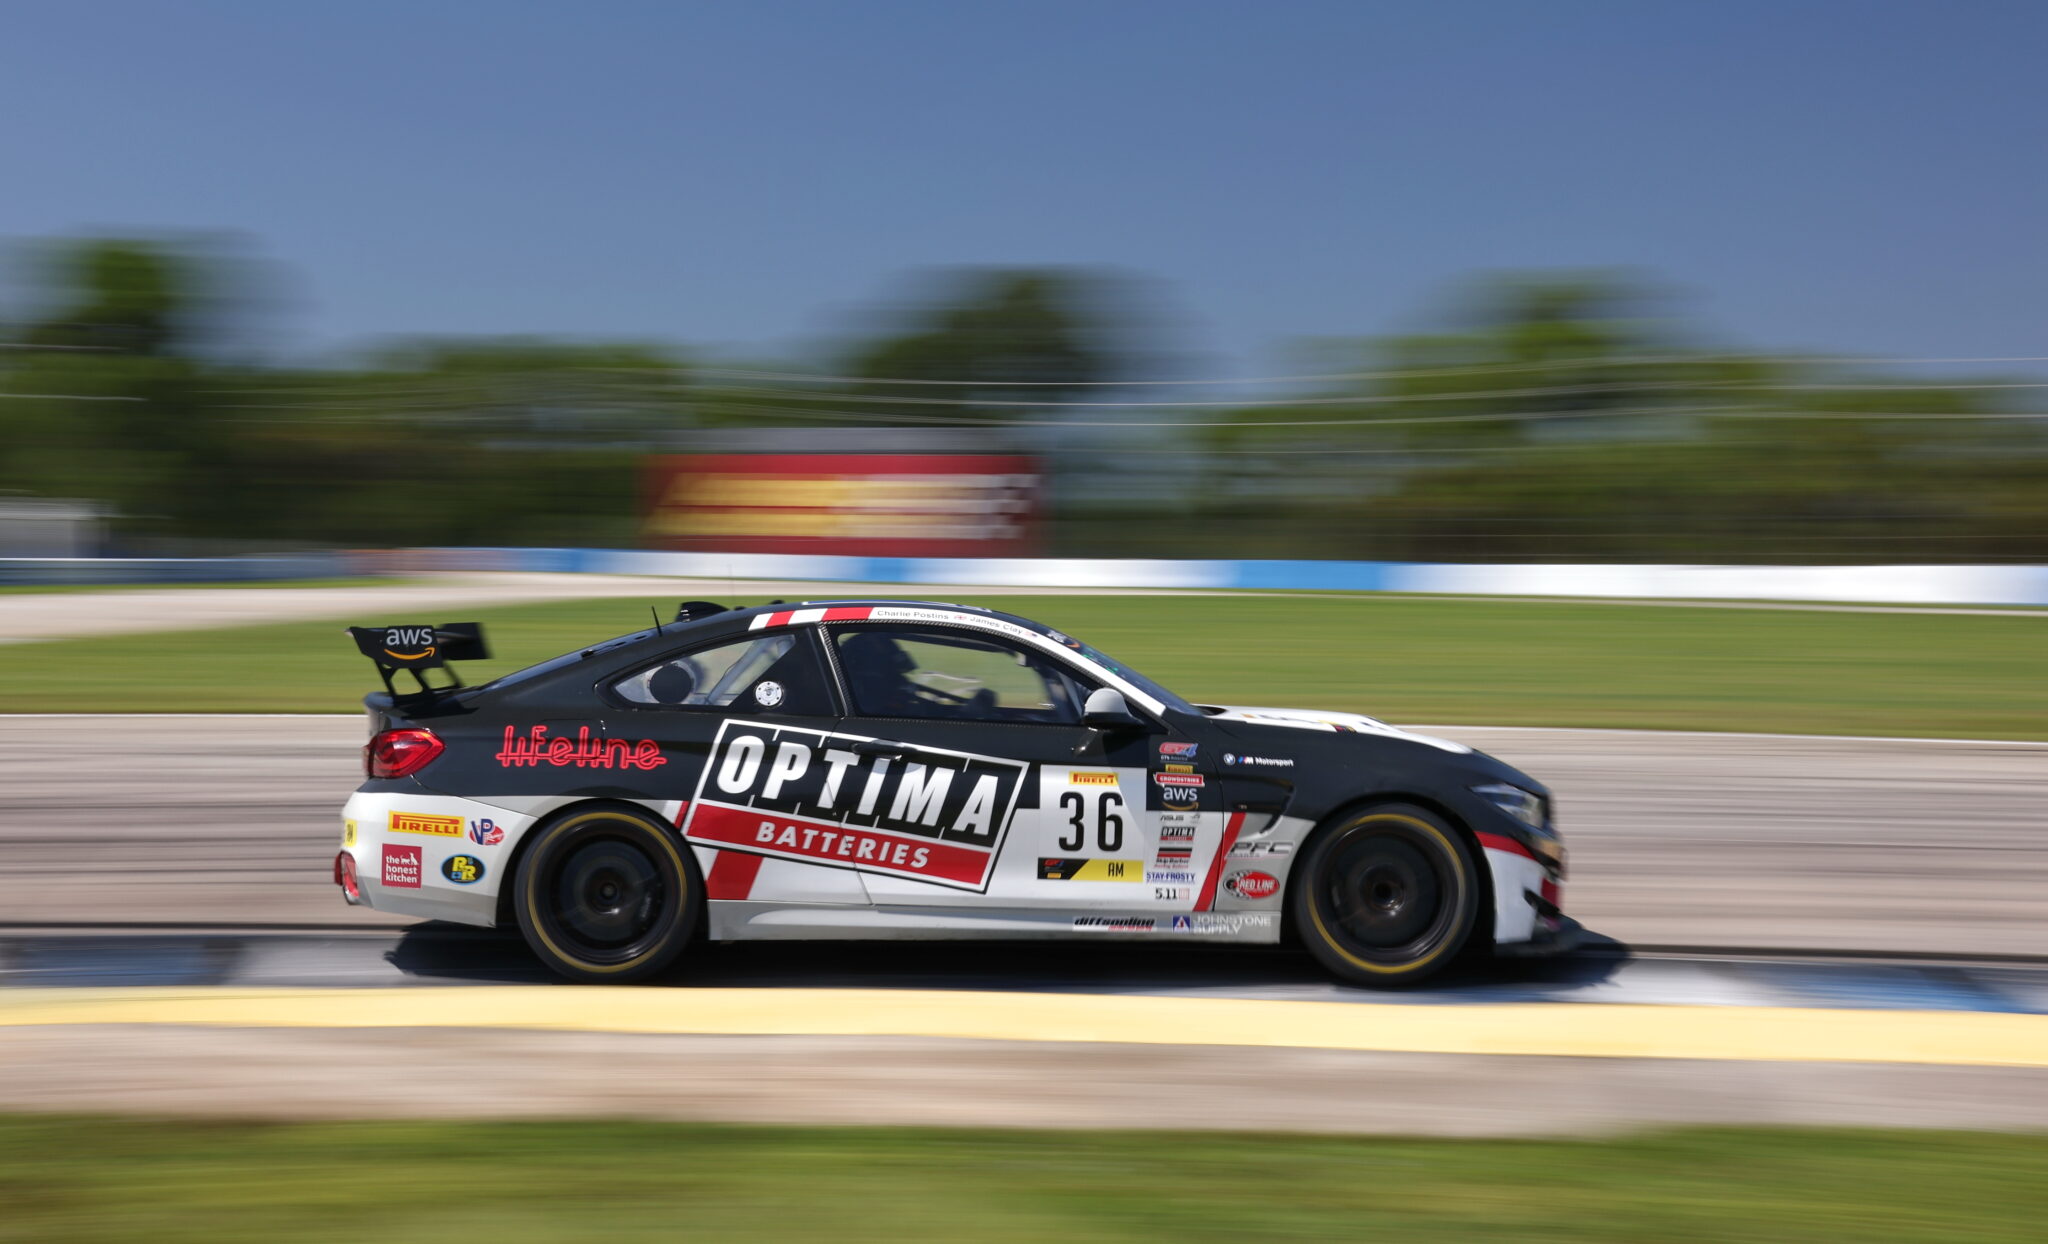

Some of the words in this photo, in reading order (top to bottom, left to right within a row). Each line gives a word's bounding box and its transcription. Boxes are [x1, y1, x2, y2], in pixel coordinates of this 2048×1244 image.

[913, 611, 949, 620] Postins
[969, 616, 1000, 628] James
[1002, 623, 1023, 635] Clay
[386, 628, 433, 646] aws
[496, 725, 667, 770] lifeline
[1255, 757, 1294, 767] Motorsport
[717, 735, 999, 836] OPTIMA
[1163, 787, 1198, 801] aws
[392, 814, 460, 834] PIRELLI
[1059, 791, 1123, 852] 36
[471, 818, 494, 845] VP
[755, 821, 931, 869] BATTERIES
[1230, 842, 1293, 853] PFC
[386, 856, 400, 864] the
[386, 864, 417, 874] honest
[1108, 862, 1124, 877] AM
[386, 873, 417, 883] kitchen
[1240, 879, 1255, 889] RED
[1256, 879, 1274, 889] LINE
[1155, 888, 1177, 900] 5.11
[1193, 915, 1271, 927] JOHNSTONE
[1193, 925, 1241, 935] SUPPLY
